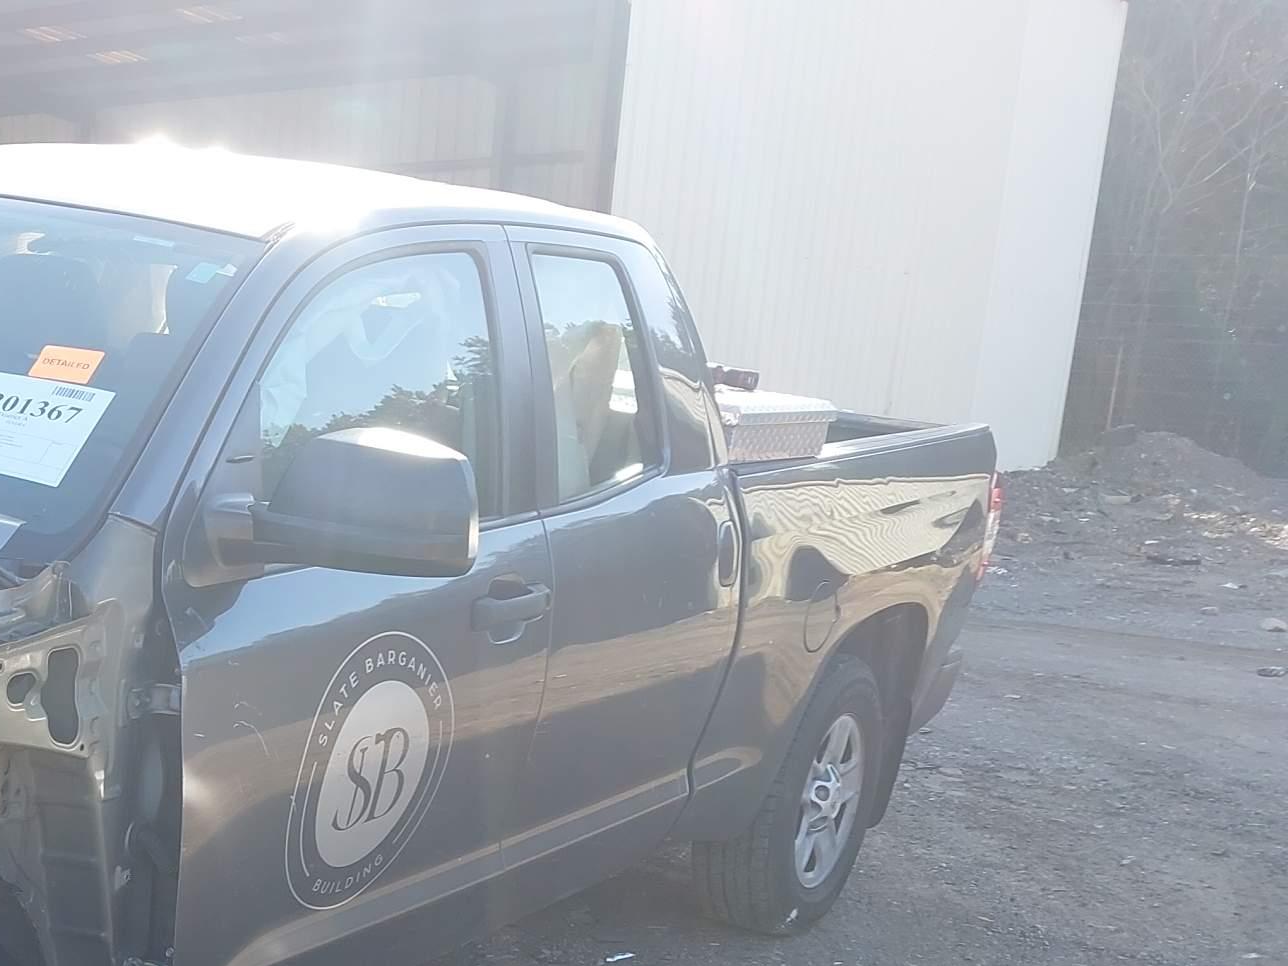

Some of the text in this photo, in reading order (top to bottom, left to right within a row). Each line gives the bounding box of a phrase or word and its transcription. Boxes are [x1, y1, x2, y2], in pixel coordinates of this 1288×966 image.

[42, 357, 90, 371] DETAILED
[318, 650, 442, 747] SLATE BARGANIER
[331, 727, 410, 831] SB
[312, 853, 383, 894] BUILDING
